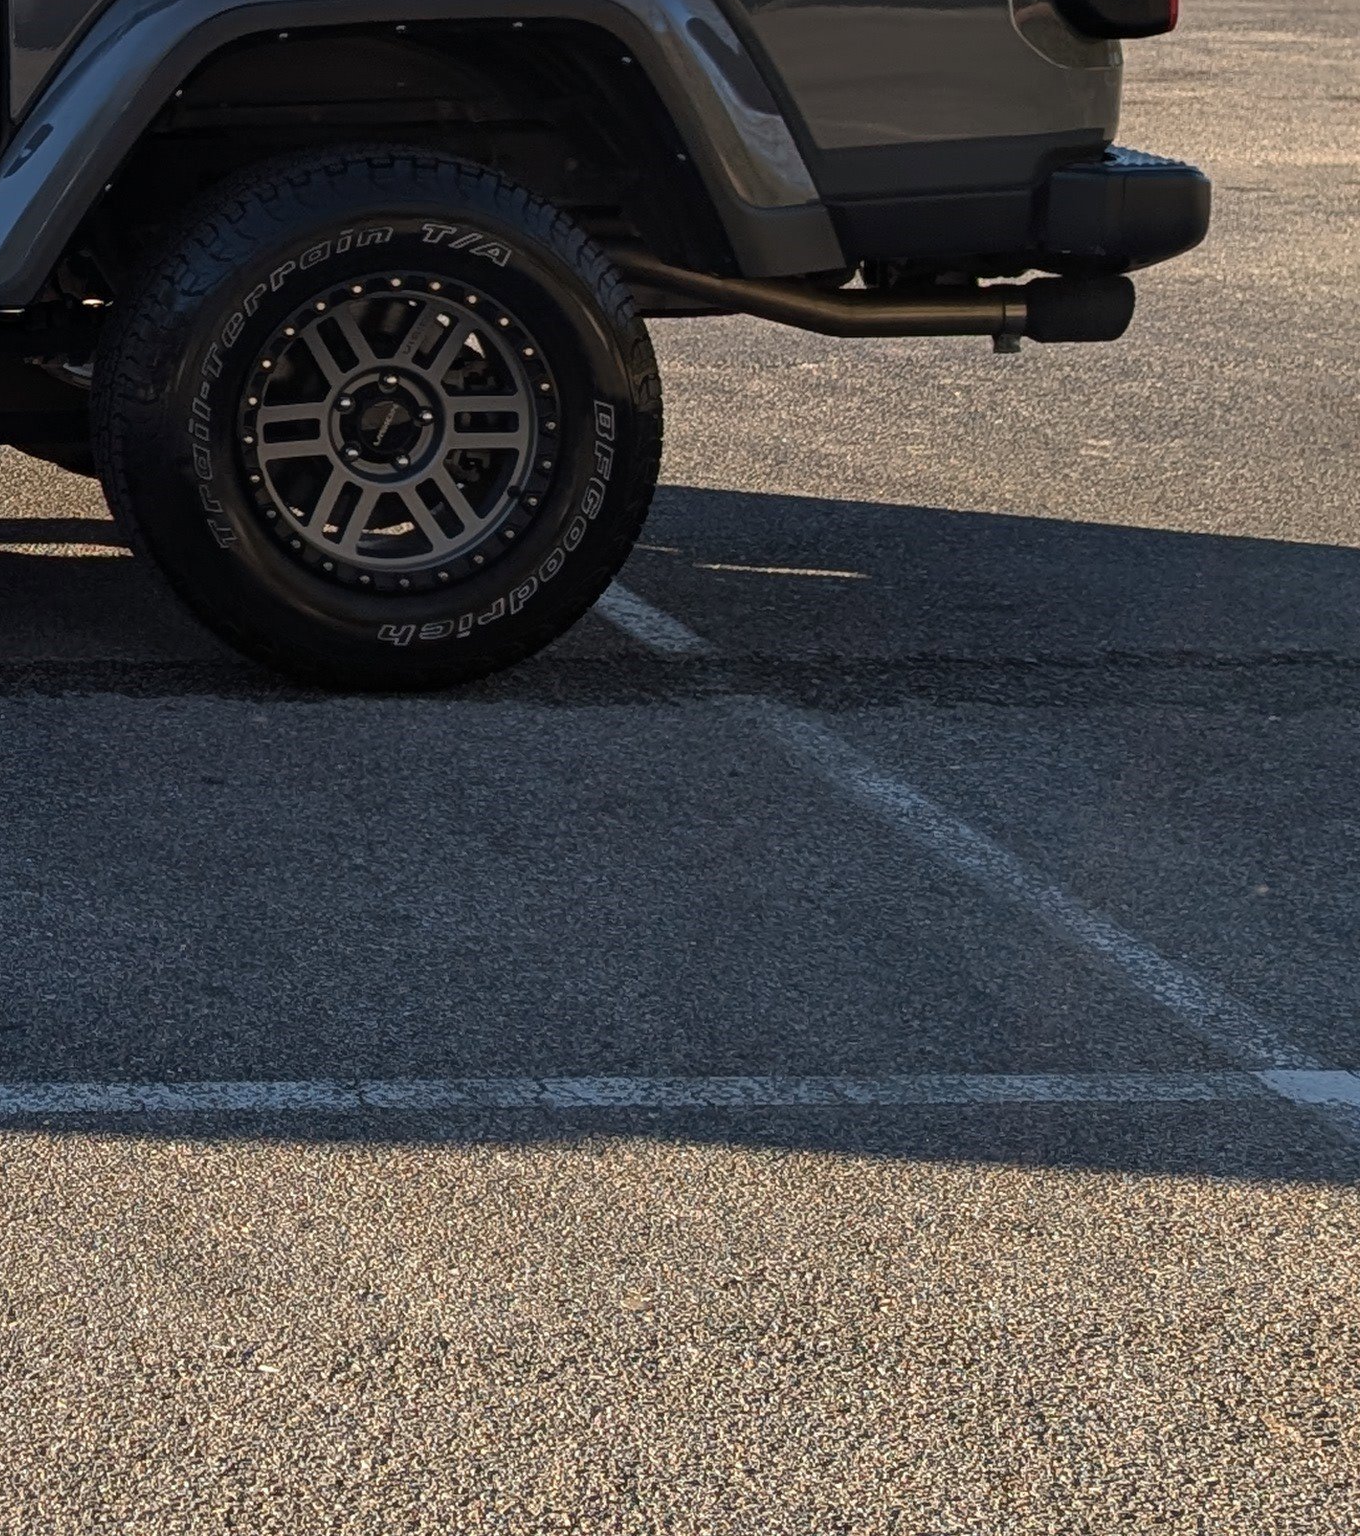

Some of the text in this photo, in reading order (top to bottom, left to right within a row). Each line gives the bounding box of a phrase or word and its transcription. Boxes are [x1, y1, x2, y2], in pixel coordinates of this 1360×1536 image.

[187, 222, 513, 549] Trail-Terrain T/A
[377, 399, 616, 647] BFGoodrich
